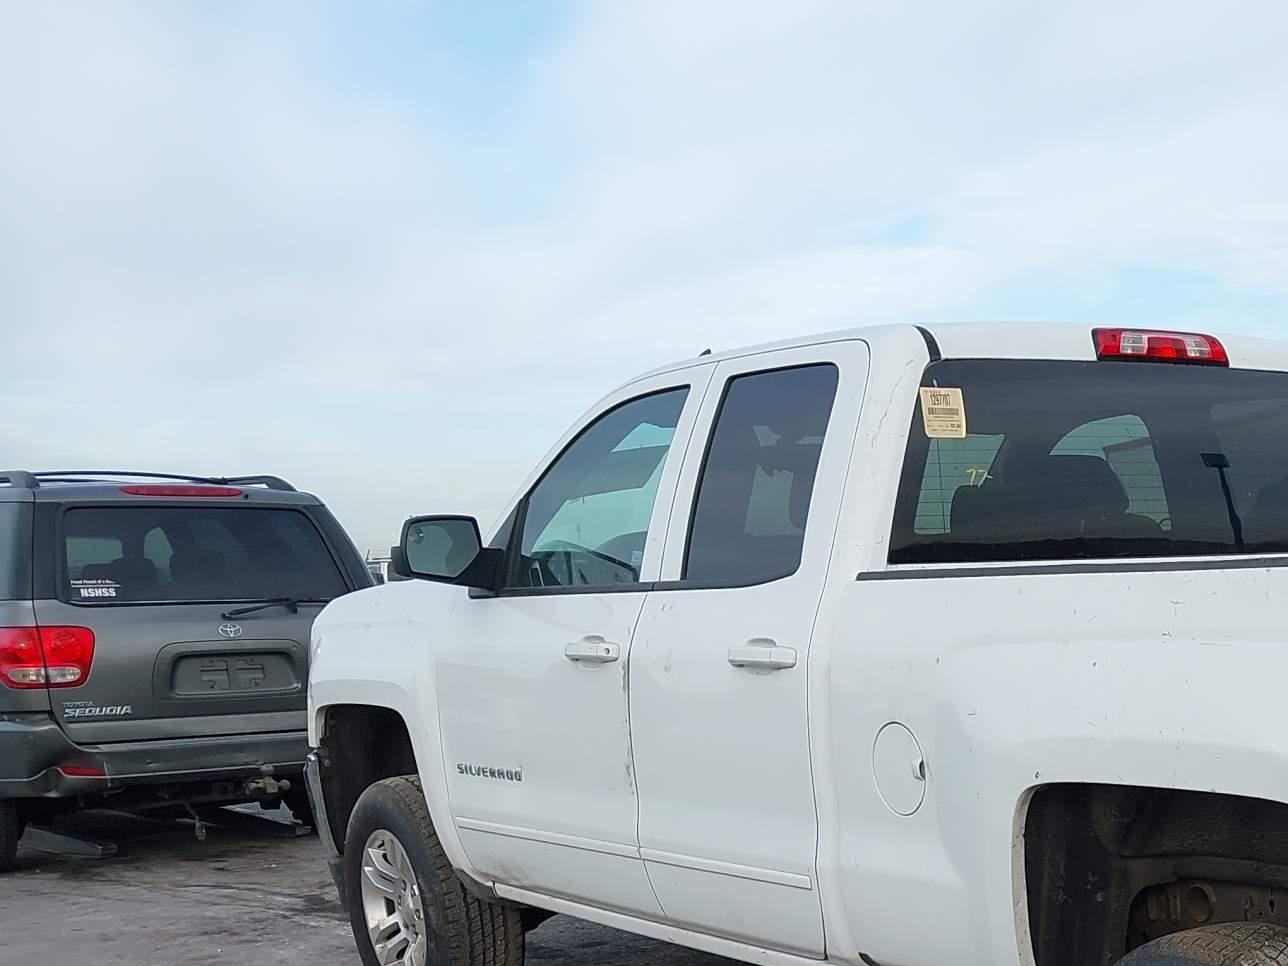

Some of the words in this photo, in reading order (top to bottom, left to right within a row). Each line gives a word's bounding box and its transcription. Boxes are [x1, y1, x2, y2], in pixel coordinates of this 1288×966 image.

[80, 587, 116, 598] NSHSS
[64, 705, 132, 718] SEQUOIA
[456, 762, 523, 781] SILVERADO
